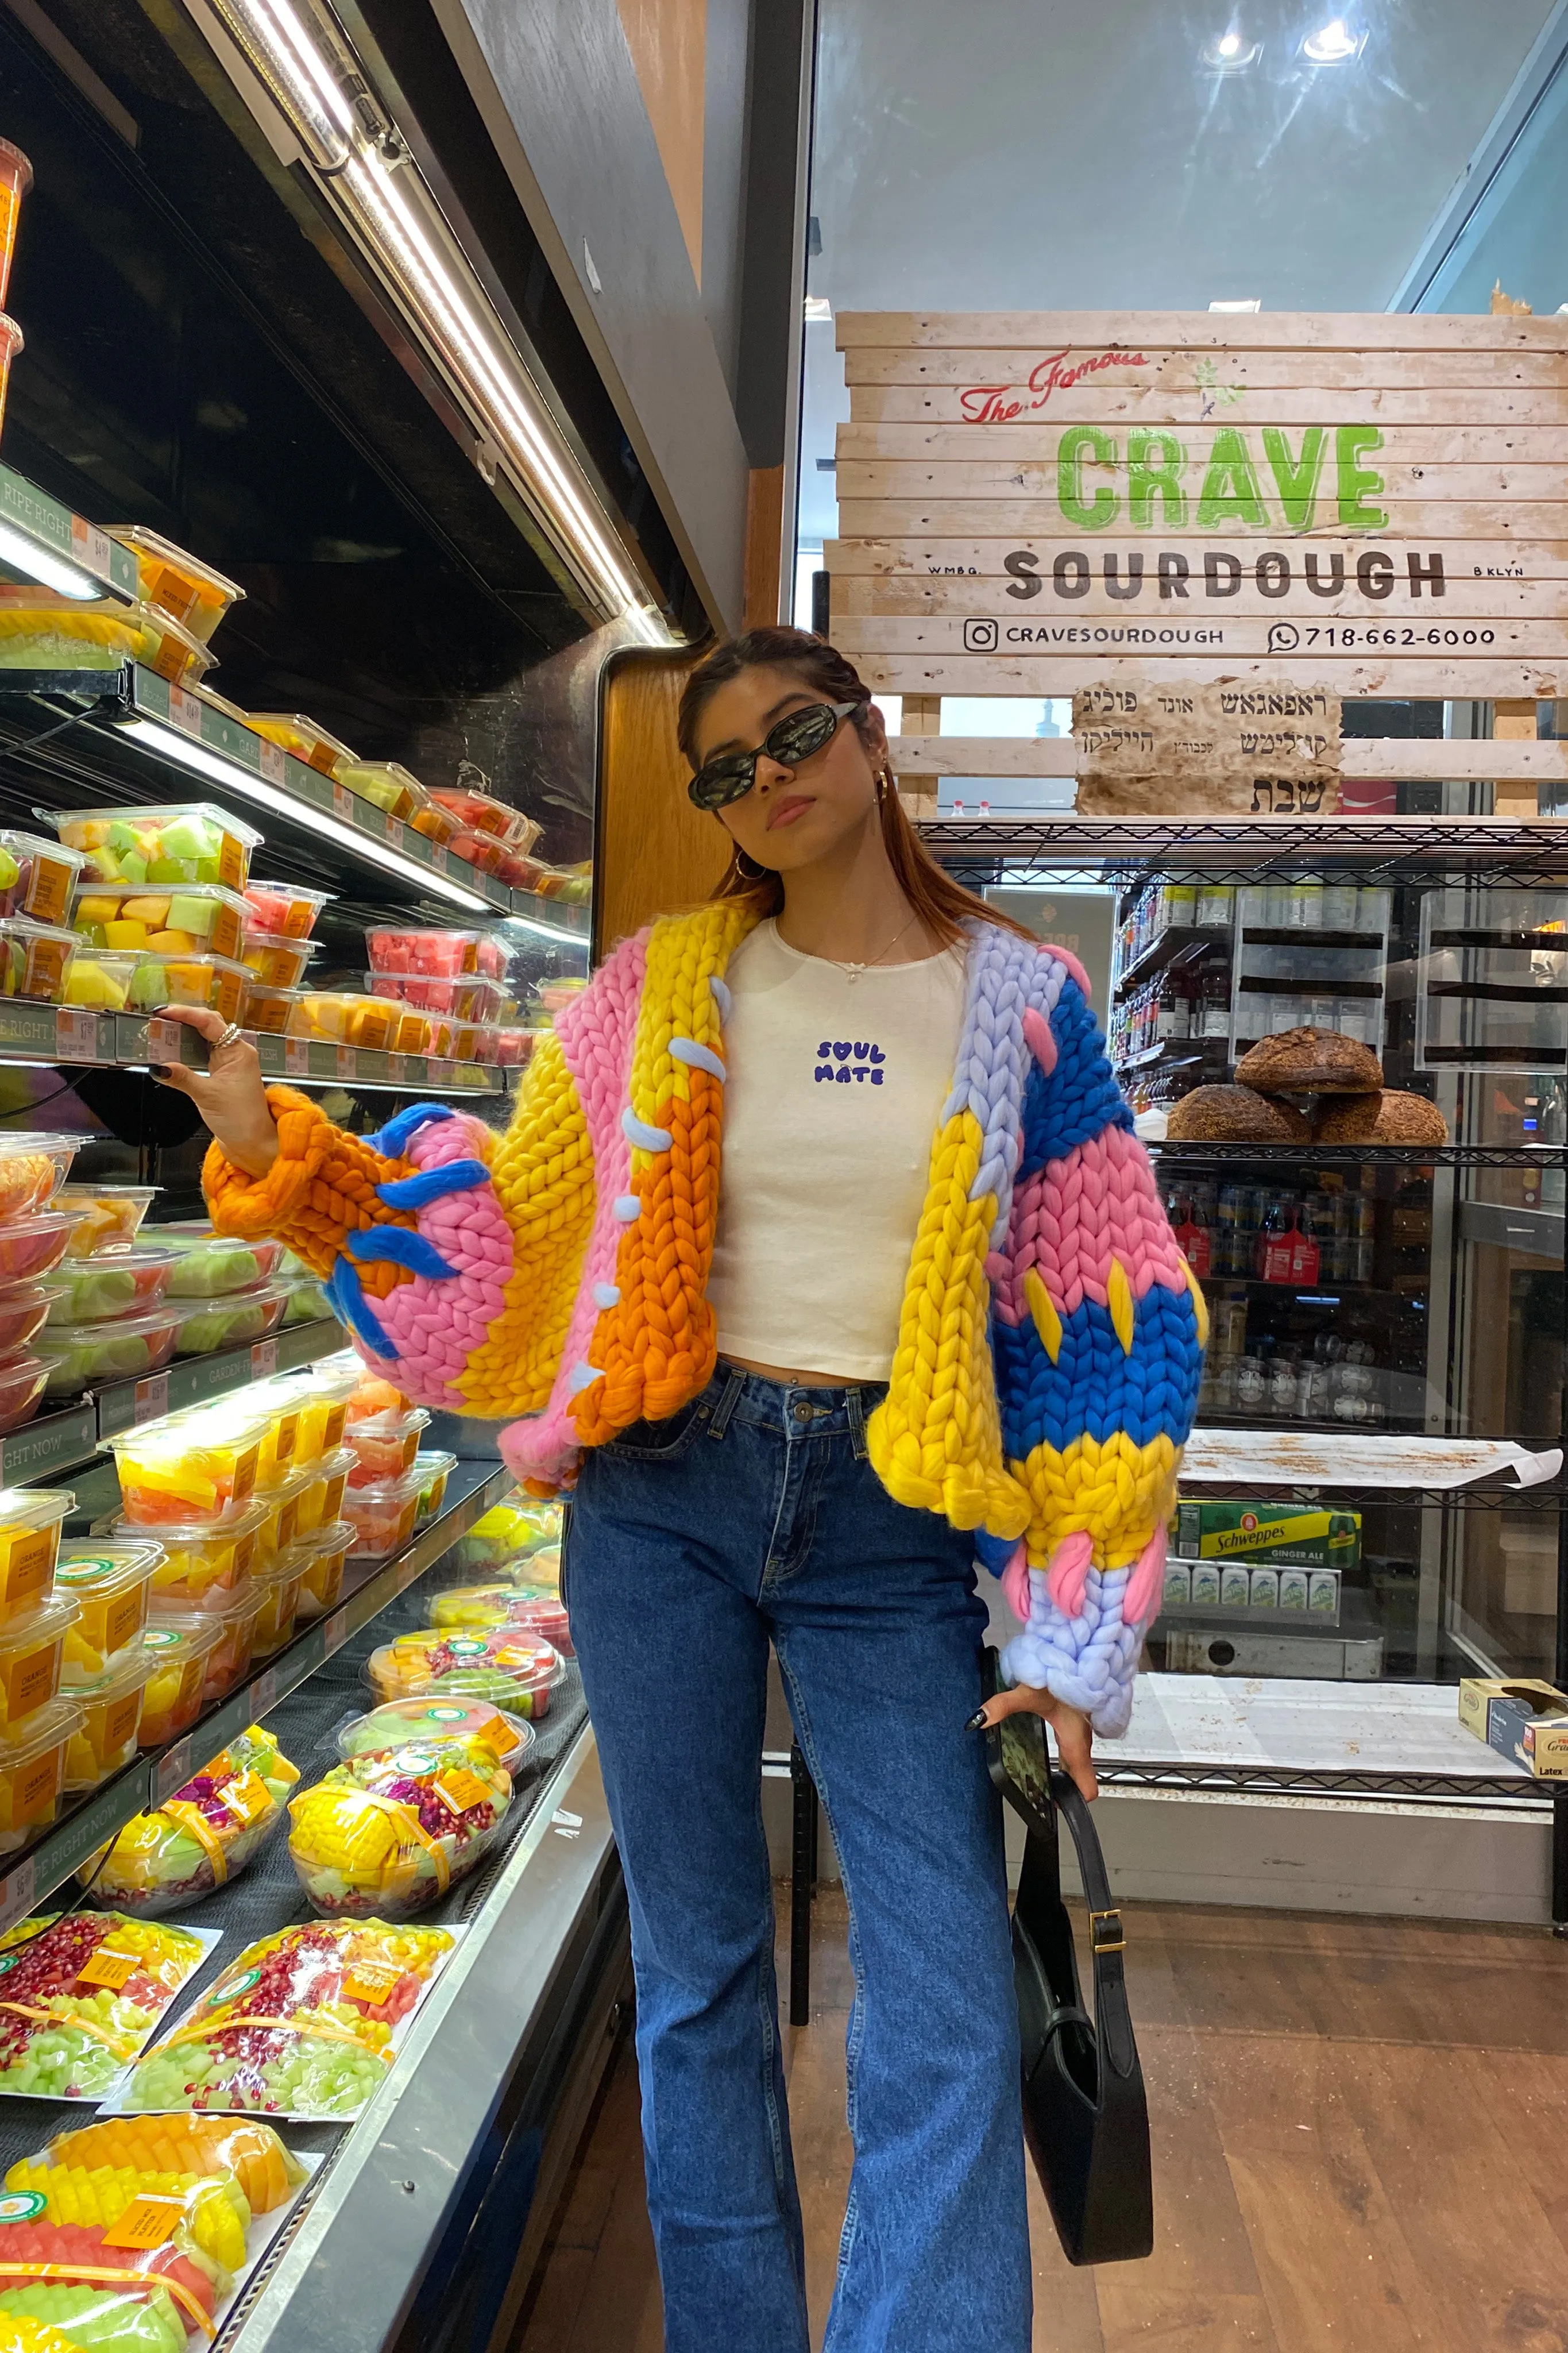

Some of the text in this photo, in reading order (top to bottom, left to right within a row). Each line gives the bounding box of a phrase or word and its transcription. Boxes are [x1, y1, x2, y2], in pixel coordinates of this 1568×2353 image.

[961, 343, 1150, 423] The Famous
[1057, 426, 1389, 530] CRAVE
[4, 483, 71, 541] RIPE RIGHT
[1004, 551, 1445, 600] SOURDOUGH
[1473, 566, 1524, 576] BKLYN
[1006, 627, 1223, 644] CRAVESOURDOUGH
[1305, 628, 1494, 646] 718-662-6000
[1250, 779, 1326, 812] שבת
[10, 1020, 49, 1041] RIGHT
[817, 1042, 886, 1064] SOUL
[814, 1064, 884, 1085] MATE
[210, 1357, 253, 1384] GARDEN-FR
[4, 1434, 63, 1469] GHT NOW
[1216, 1526, 1285, 1553] Schweppes
[20, 1546, 45, 1564] ORANGE
[1272, 1549, 1324, 1560] GINGER ALE
[21, 1665, 48, 1686] ORANGE
[1539, 1767, 1563, 1776] Latex
[51, 1823, 88, 1865] RIGHT
[90, 1798, 119, 1833] NOW
